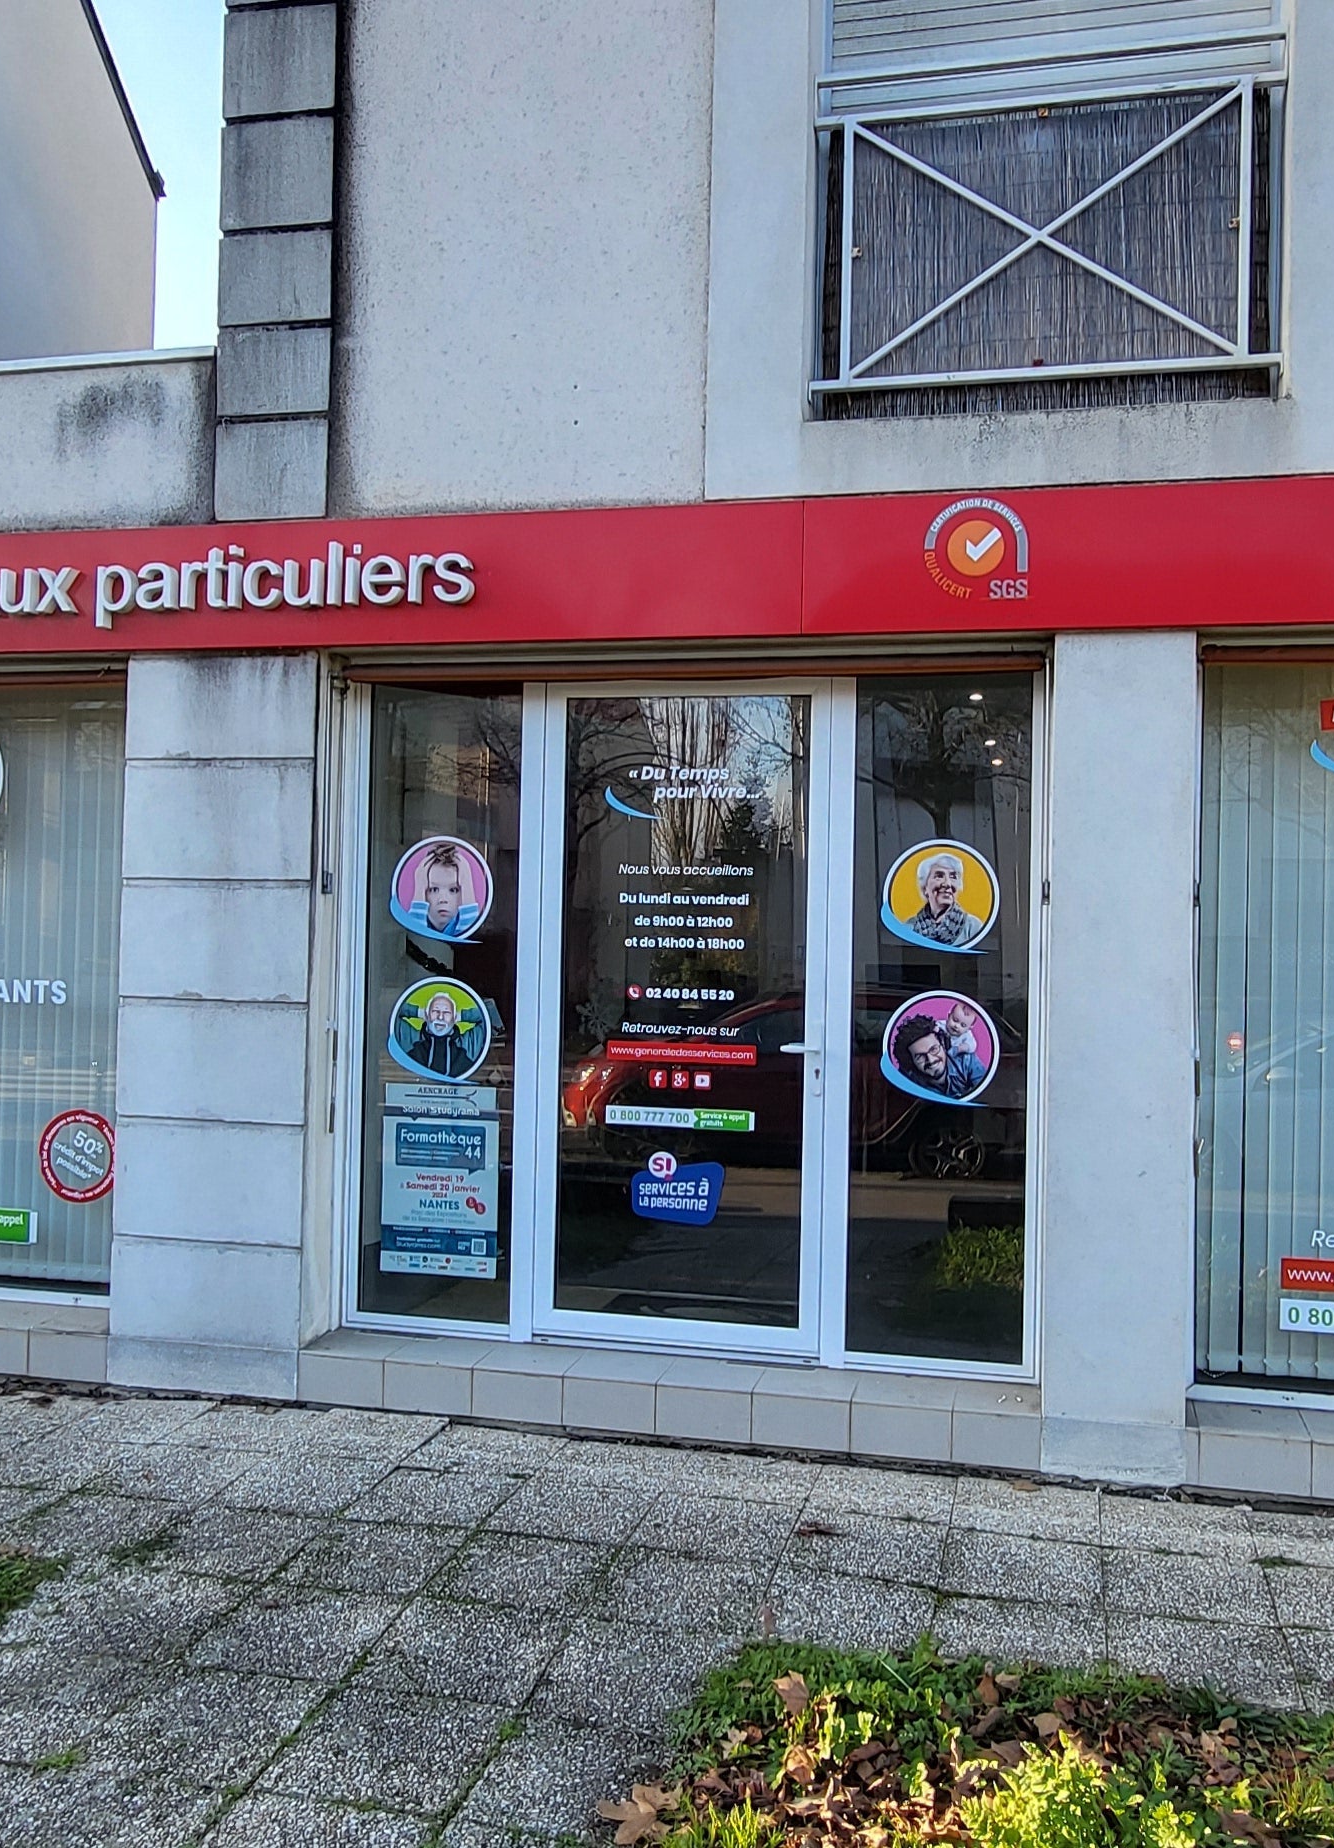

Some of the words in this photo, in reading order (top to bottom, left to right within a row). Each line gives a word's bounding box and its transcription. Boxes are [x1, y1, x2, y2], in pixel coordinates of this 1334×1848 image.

[982, 499, 993, 509] DE
[992, 502, 1023, 532] SERVICES
[924, 551, 972, 599] QUALICERT
[94, 540, 475, 630] particuliers
[989, 579, 1028, 599] SGS
[641, 766, 665, 781] Du
[670, 767, 729, 784] Temps
[653, 785, 698, 803] pour
[619, 864, 649, 875] Nous
[652, 866, 680, 875] vous
[683, 864, 754, 877] accueillons
[619, 893, 637, 904] Du
[639, 893, 670, 904] lundi
[673, 895, 690, 905] au
[692, 894, 749, 906] vendredi
[634, 915, 650, 926] de
[652, 916, 683, 927] 9h00
[686, 915, 695, 927] à
[697, 916, 733, 928] 12h00
[624, 938, 638, 948] et
[640, 937, 656, 948] de
[657, 937, 694, 949] 14h00
[697, 937, 705, 949] à
[708, 938, 744, 950] 18h00
[645, 988, 661, 999] 02
[663, 988, 680, 1000] 40
[681, 989, 698, 1000] 84
[701, 989, 717, 1001] 55
[718, 989, 734, 1001] 20
[621, 1022, 717, 1036] Retrouvez-nous
[719, 1026, 740, 1037] sur
[620, 1110, 641, 1121] 800
[643, 1111, 664, 1122] 777
[668, 1112, 690, 1123] 700
[401, 1129, 482, 1148] Formathèque
[465, 1146, 481, 1159] 44
[416, 1173, 453, 1183] Vendredi
[406, 1181, 437, 1190] Samedi
[452, 1184, 480, 1194] janvier
[419, 1199, 460, 1210] NANTES
[1288, 1306, 1300, 1324] 0
